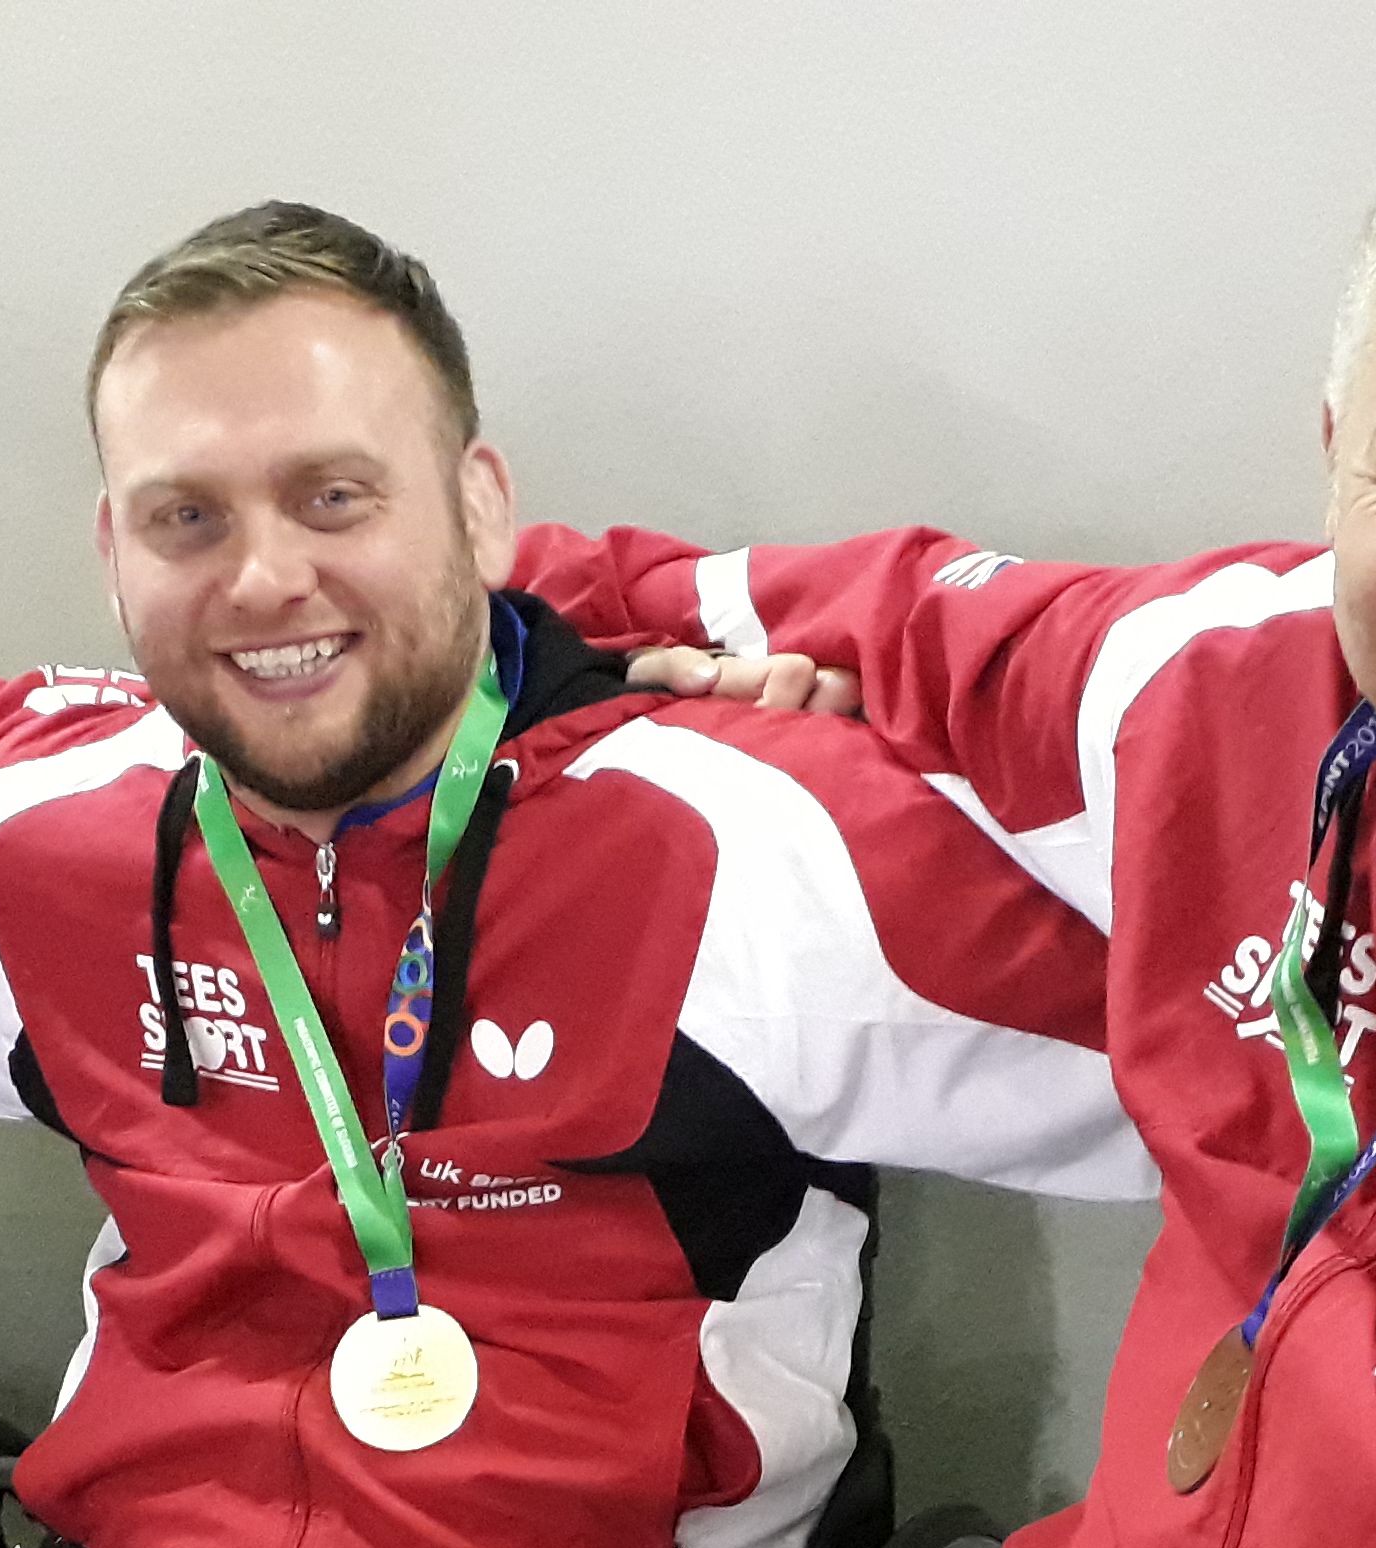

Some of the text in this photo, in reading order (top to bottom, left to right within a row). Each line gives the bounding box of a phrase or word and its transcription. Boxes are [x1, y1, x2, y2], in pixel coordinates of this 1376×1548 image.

[139, 1002, 268, 1073] SORT
[419, 1157, 464, 1185] uk
[457, 1184, 562, 1211] FUNDED
